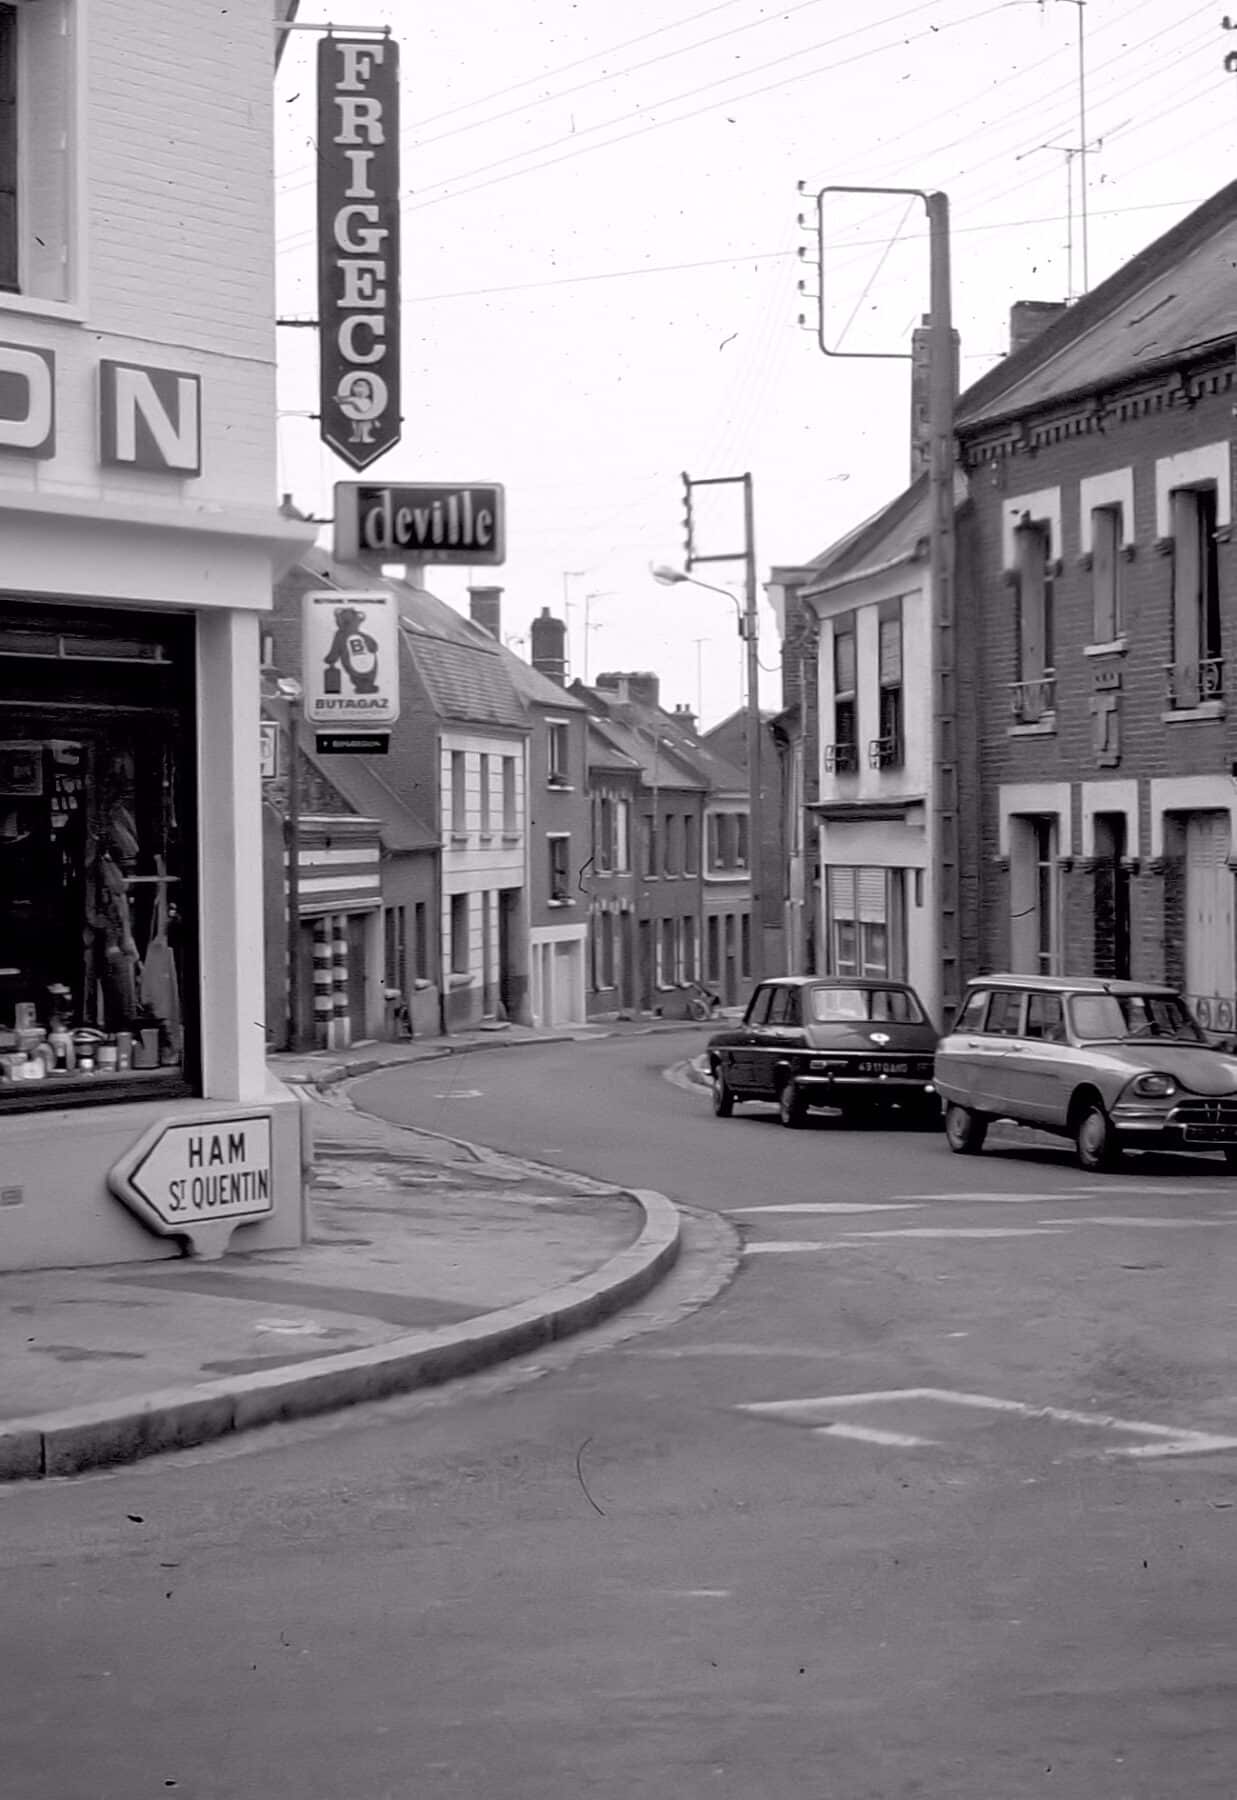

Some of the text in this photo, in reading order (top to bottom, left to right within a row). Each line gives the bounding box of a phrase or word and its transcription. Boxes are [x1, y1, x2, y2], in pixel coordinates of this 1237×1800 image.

[333, 43, 389, 421] FRIGECO
[365, 489, 493, 549] deville
[350, 638, 364, 653] B
[314, 698, 389, 709] BUTAGAZ
[189, 1133, 245, 1168] HAM
[192, 1169, 268, 1209] QUENTIN
